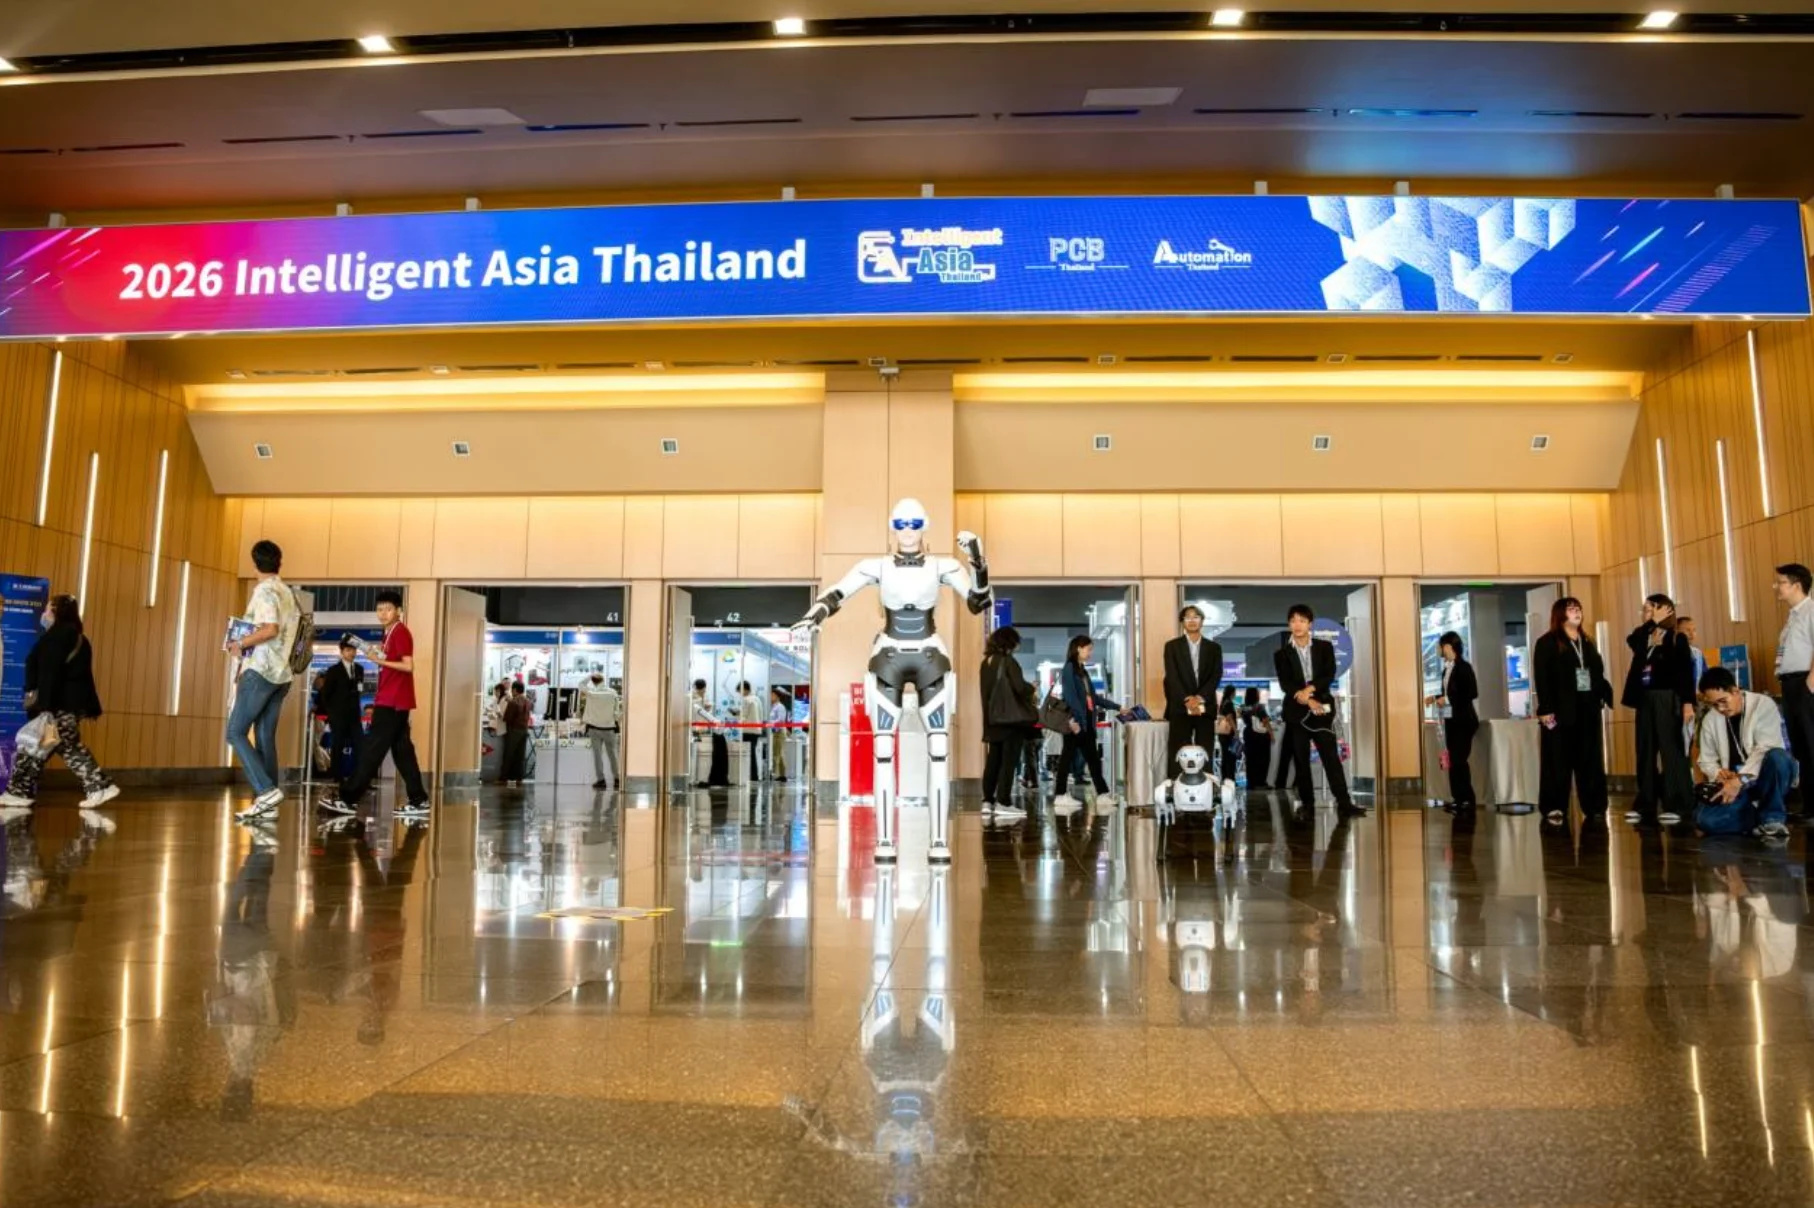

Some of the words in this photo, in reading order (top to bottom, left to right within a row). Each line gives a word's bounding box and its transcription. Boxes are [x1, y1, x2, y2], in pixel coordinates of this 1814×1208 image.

[902, 227, 1003, 248] Intelligent
[918, 248, 974, 273] Asia
[1049, 237, 1105, 263] PCB
[1152, 239, 1252, 264] Automation
[119, 261, 224, 300] 2026
[234, 249, 473, 301] Intelligent
[481, 244, 580, 288] Asia
[592, 238, 807, 284] Thailand
[941, 272, 983, 282] Thailand
[606, 611, 619, 623] 41
[726, 612, 741, 623] 42
